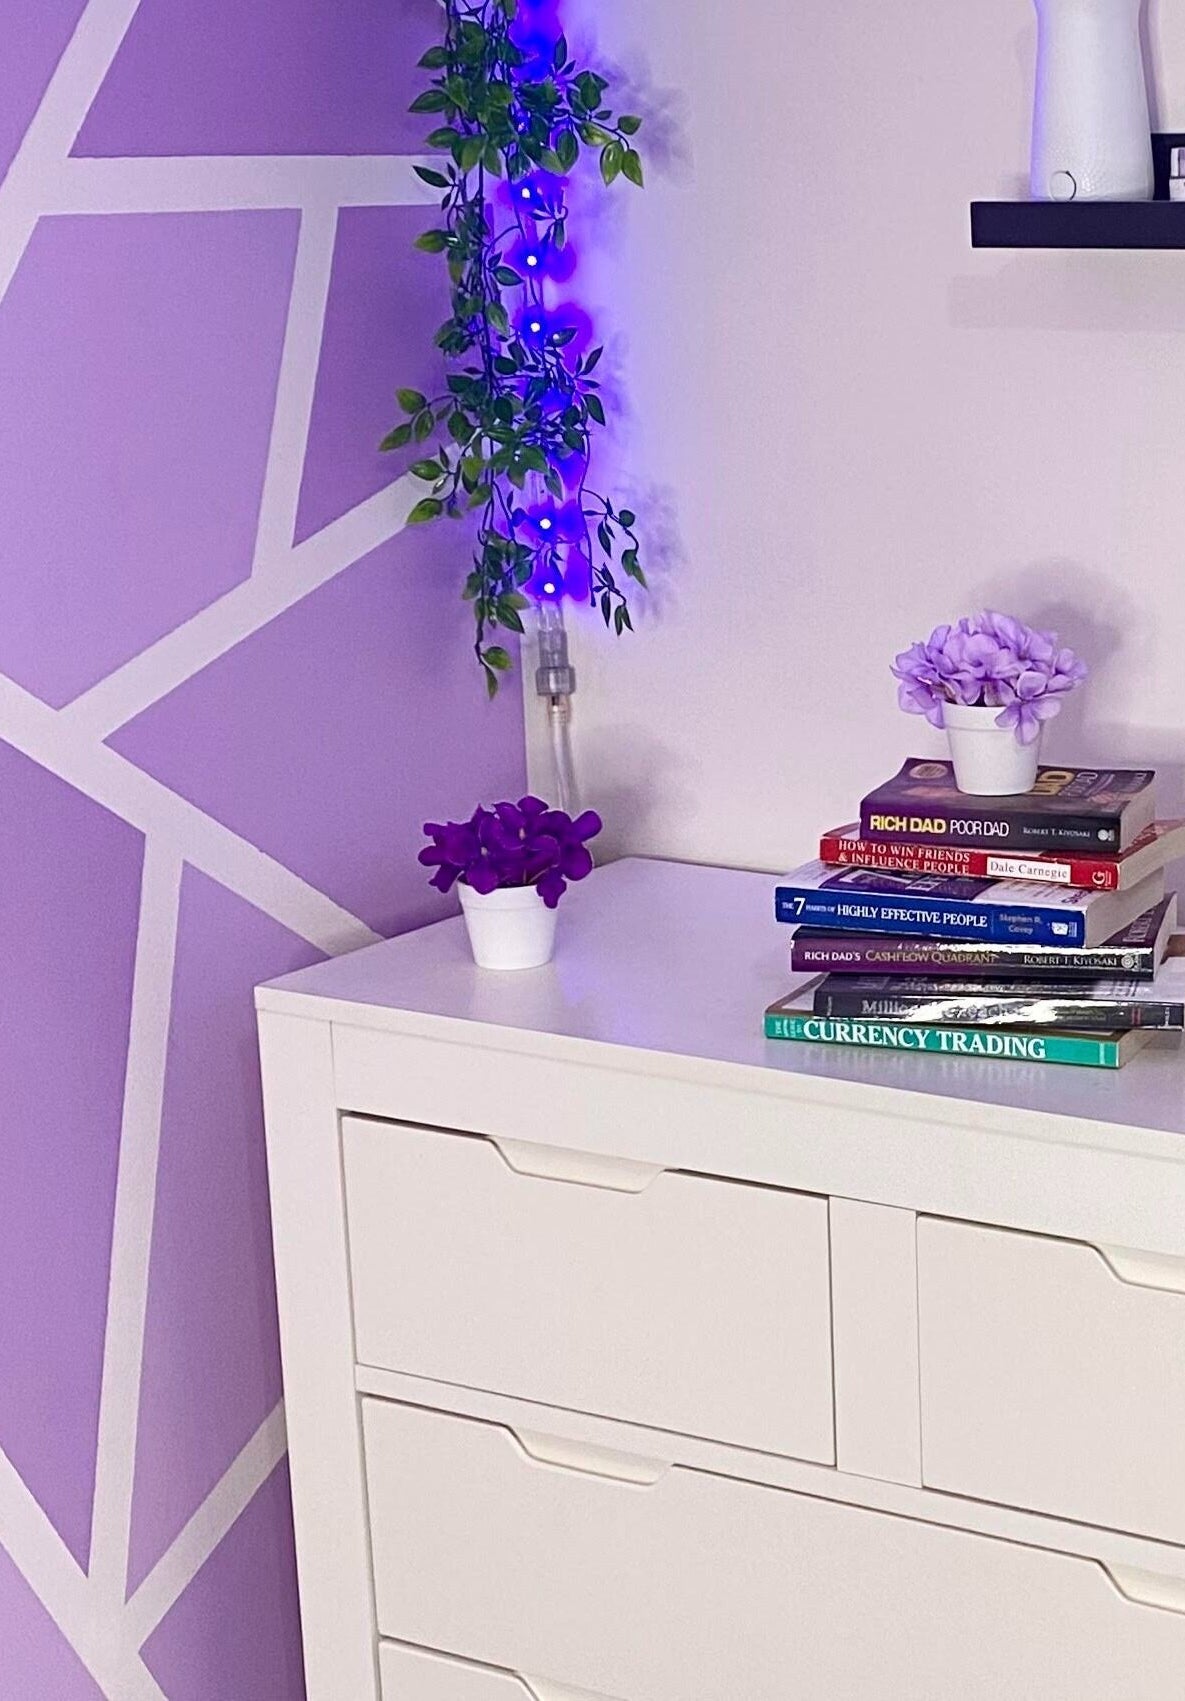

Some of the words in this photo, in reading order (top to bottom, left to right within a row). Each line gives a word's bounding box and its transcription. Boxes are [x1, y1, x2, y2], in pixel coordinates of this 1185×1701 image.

[870, 814, 907, 832] RICH
[910, 817, 946, 834] DAD
[950, 819, 982, 836] POOR
[983, 821, 1009, 837] DAD
[838, 840, 866, 852] HOW
[870, 843, 887, 854] TO
[890, 845, 914, 857] WIN
[917, 848, 970, 863] FRIENDS
[838, 851, 848, 862] &
[851, 853, 920, 870] INFLUENCE
[923, 860, 970, 874] PEOPLE
[990, 861, 1015, 873] Dale
[1018, 864, 1068, 880] Carnegie
[793, 897, 806, 916] 7
[837, 904, 878, 919] HIGHLY
[881, 907, 941, 924] EFFECTIVE
[942, 912, 988, 928] PEOPLE
[804, 951, 831, 961] RICH
[831, 951, 861, 961] DAD'S
[865, 950, 930, 962] CASHFLOW
[931, 951, 996, 965] QUADRANT
[1023, 954, 1059, 965] ROBERT
[803, 1020, 930, 1049] CURRENCY
[936, 1030, 1046, 1059] TRADING
